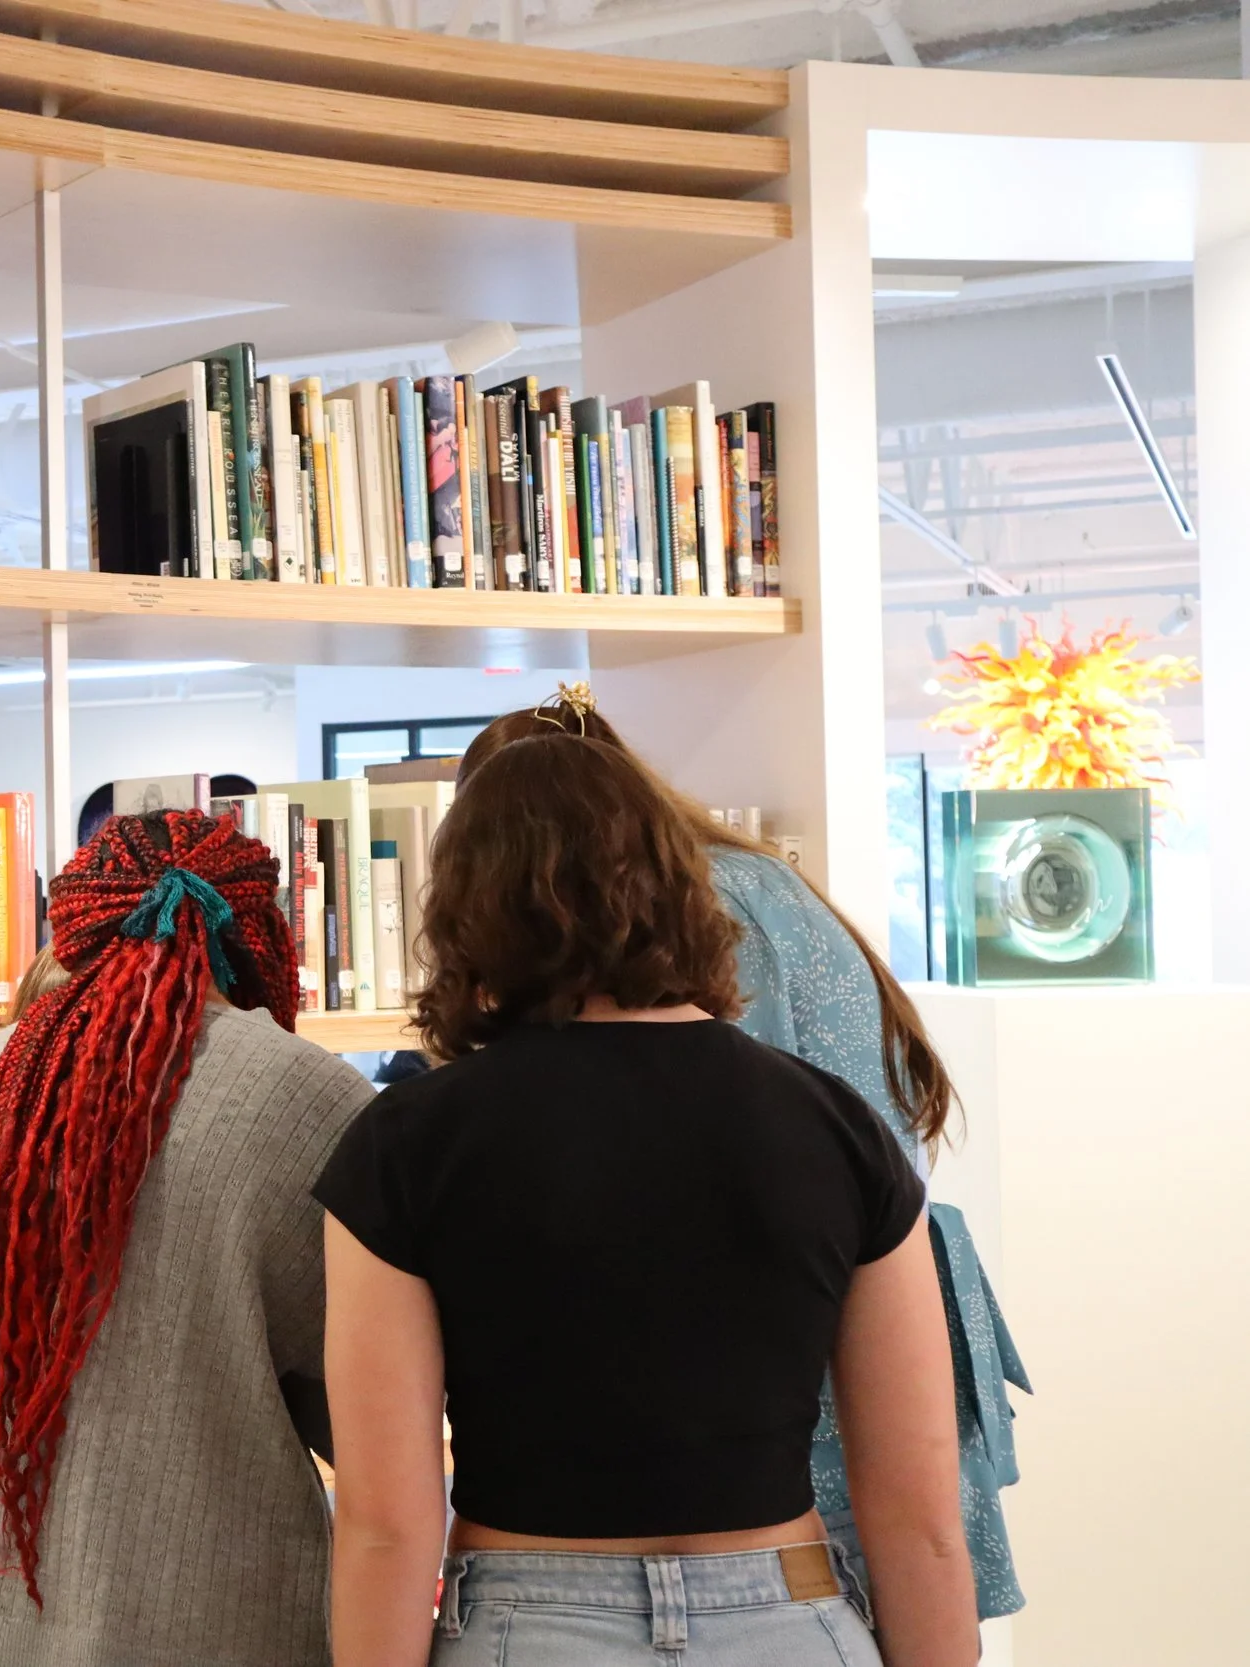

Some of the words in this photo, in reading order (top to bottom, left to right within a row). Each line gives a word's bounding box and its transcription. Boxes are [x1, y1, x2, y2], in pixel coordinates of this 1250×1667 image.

[219, 377, 230, 436] HENRI
[498, 397, 509, 438] Essential
[560, 395, 573, 436] HIROSHI
[536, 494, 546, 533] Martiros
[293, 851, 304, 875] Andy
[310, 827, 318, 872] BRITISH
[295, 877, 305, 910] Warhol
[357, 857, 369, 910] BRAQUE
[296, 913, 305, 942] Prints
